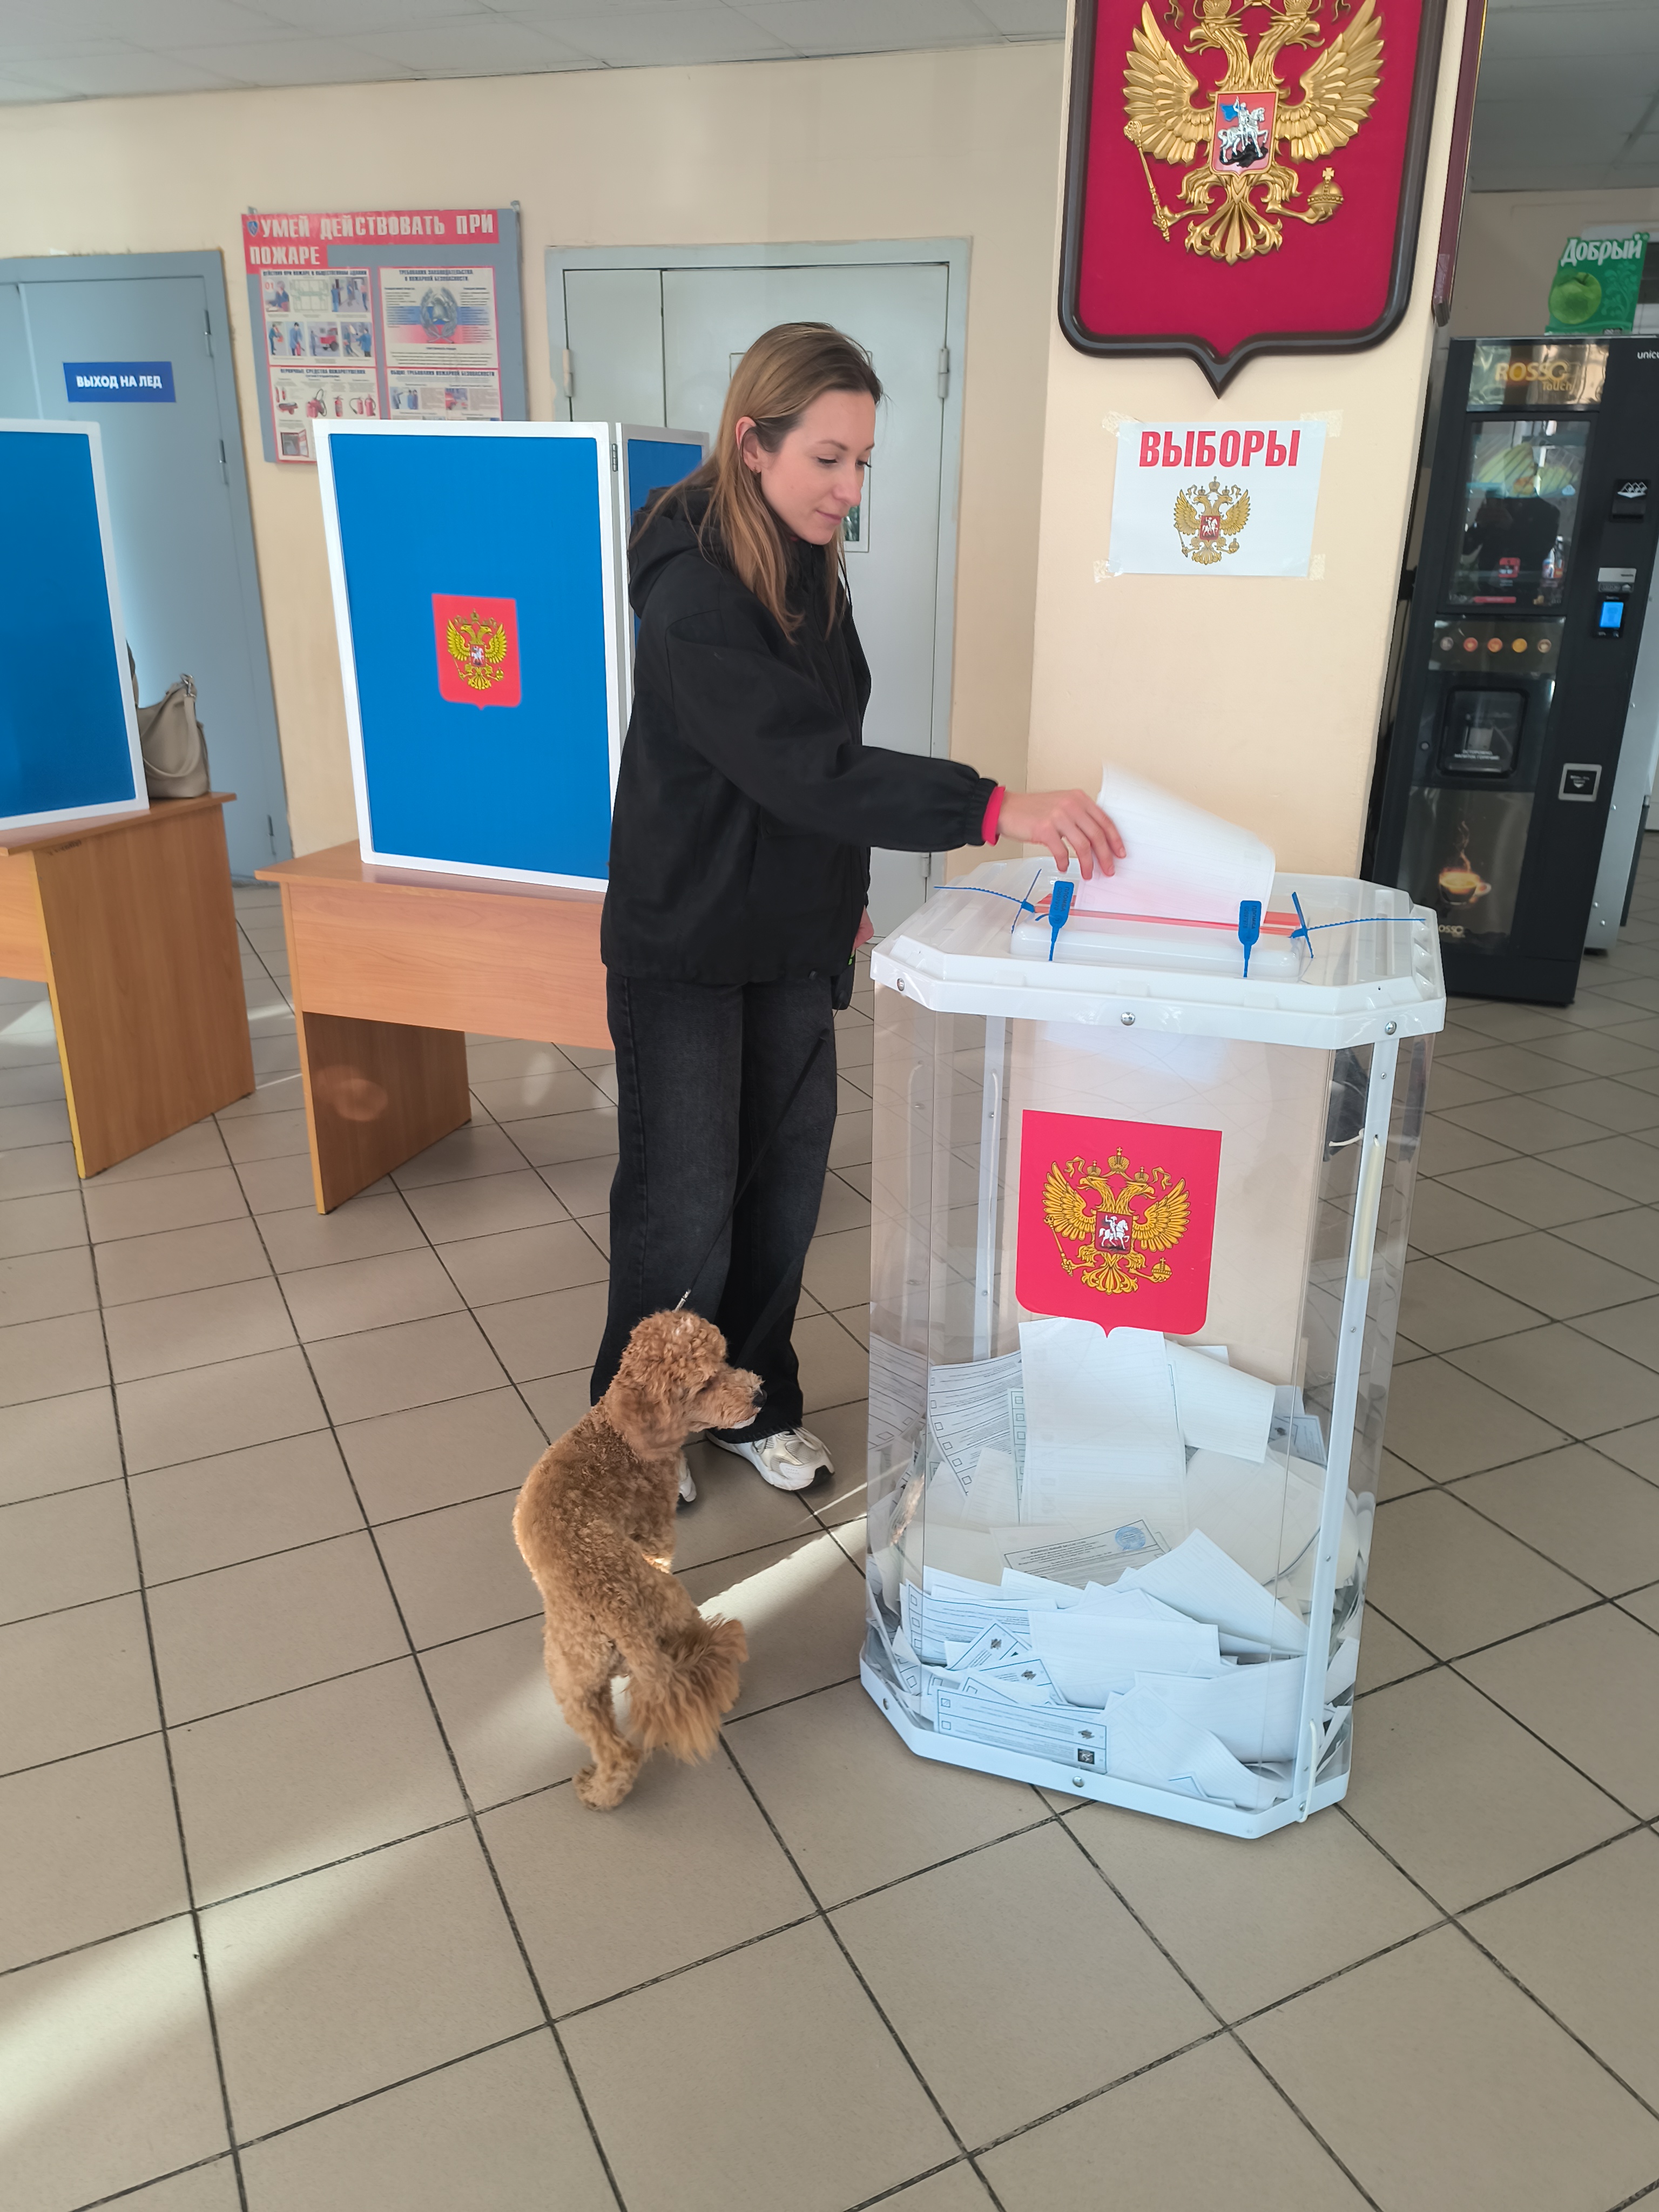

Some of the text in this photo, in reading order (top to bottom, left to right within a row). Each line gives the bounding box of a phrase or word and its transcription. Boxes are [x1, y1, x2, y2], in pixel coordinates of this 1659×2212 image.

[261, 214, 493, 240] УМЕЙ ДЕЙСТВОВАТЬ ПРИ
[249, 246, 320, 265] ПОЖАРЕ
[1561, 233, 1643, 267] Добрый
[76, 375, 163, 389] ВЫХОД НА ЛЕД
[1542, 380, 1572, 391] Touch
[1139, 429, 1301, 468] ВЫБОРЫ
[1061, 887, 1070, 912] ПЛОМБА
[1439, 925, 1464, 934] OSSO
